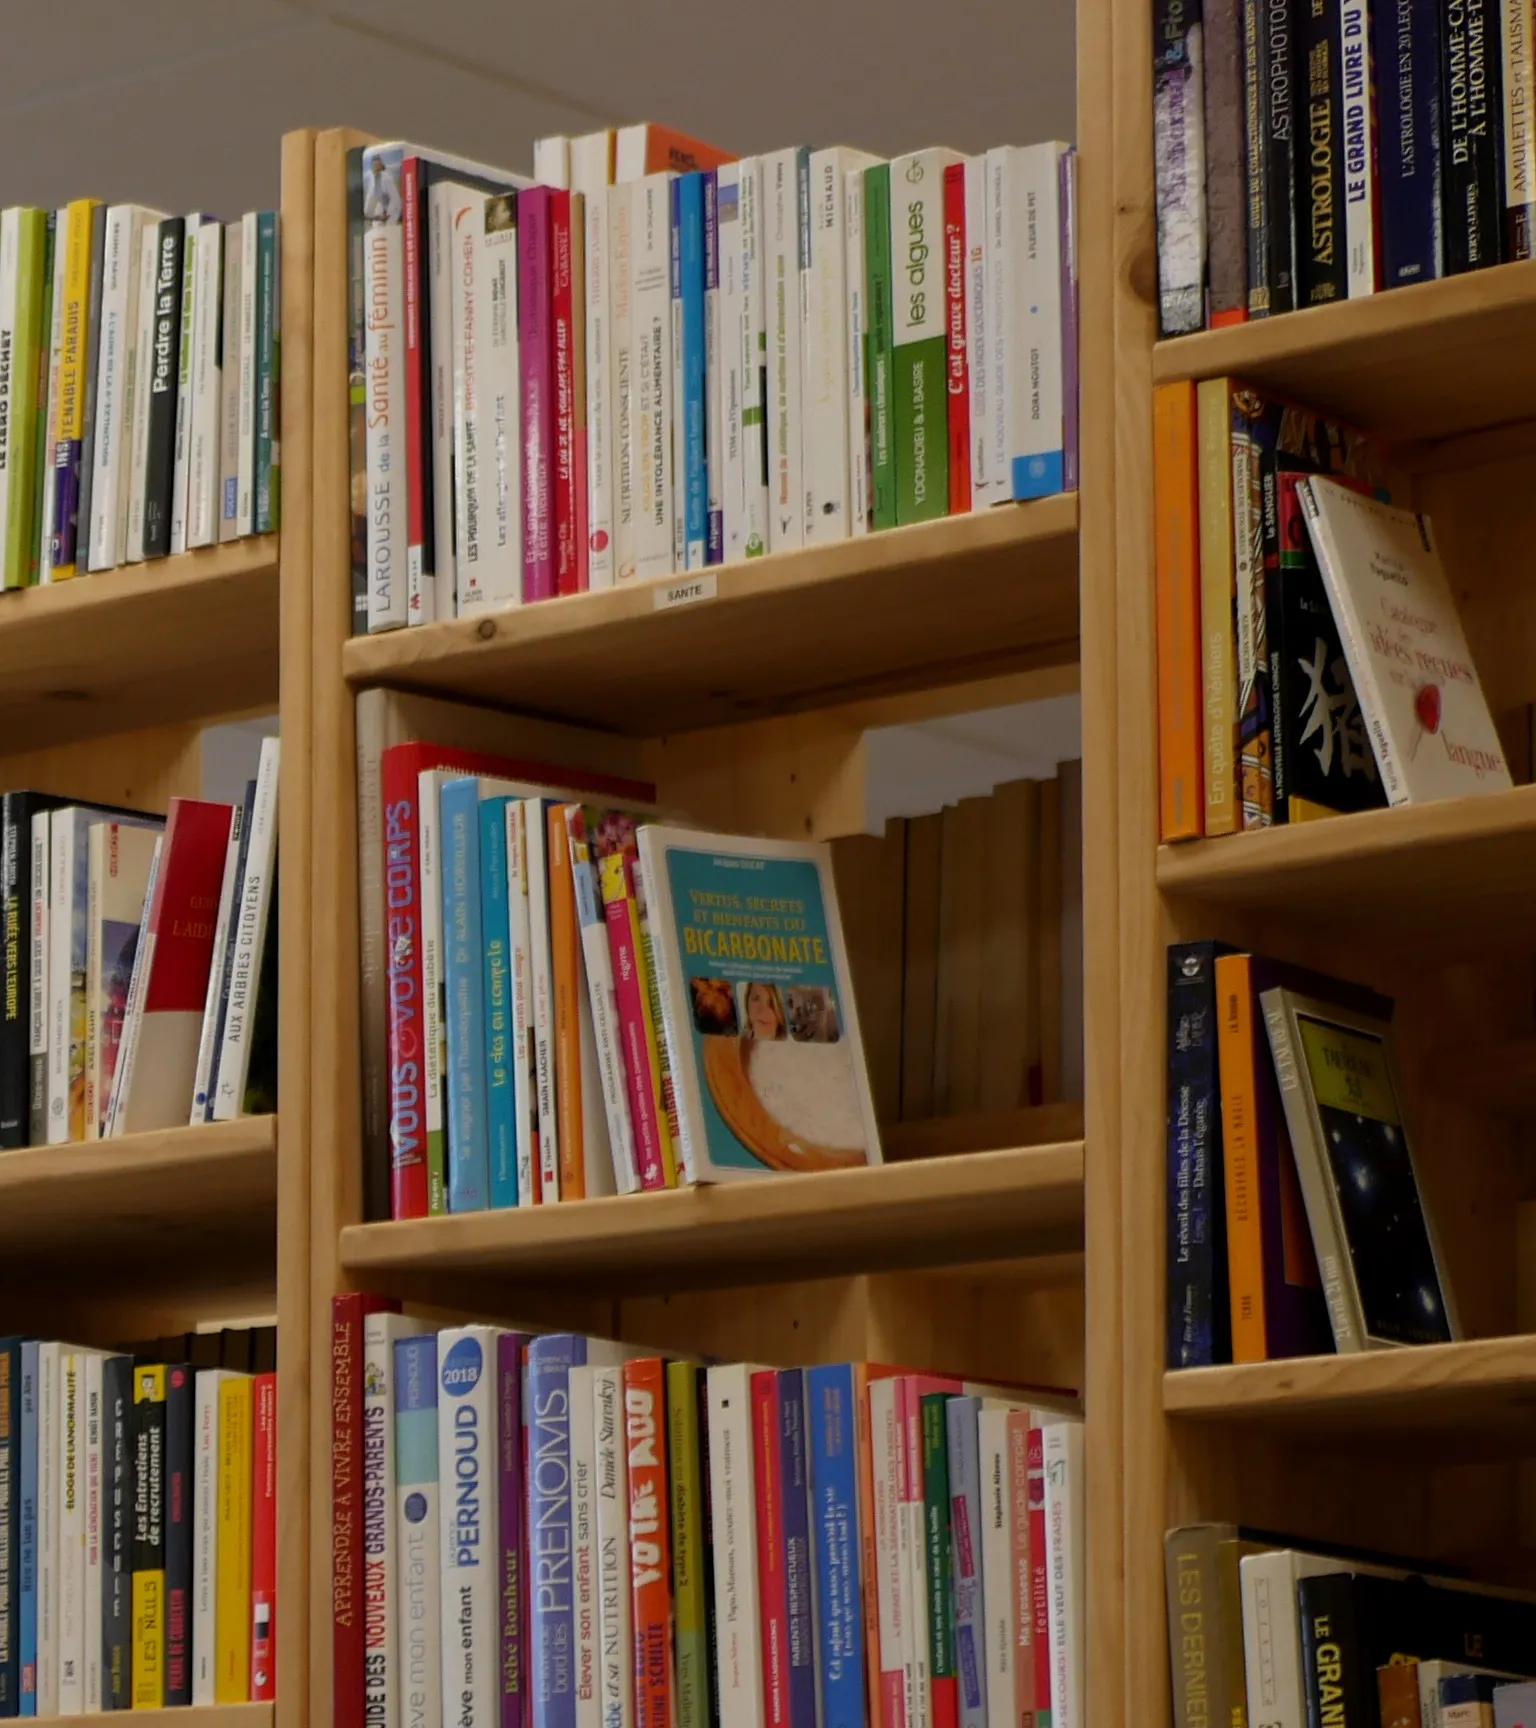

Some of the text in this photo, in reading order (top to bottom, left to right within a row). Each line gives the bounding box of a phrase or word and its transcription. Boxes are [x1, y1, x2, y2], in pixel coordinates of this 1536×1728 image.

[1400, 34, 1413, 49] 20
[1401, 54, 1413, 72] EN
[1343, 9, 1366, 203] LE GRAND LIVRE DU
[1400, 75, 1415, 177] L'ASTROLOGIE
[1452, 135, 1469, 164] DE
[1465, 121, 1486, 136] À
[1512, 88, 1526, 192] AMULETTES
[1309, 99, 1334, 265] ASTROLOGIE
[153, 237, 174, 392] Perdre la Terre
[905, 201, 927, 327] les algues
[946, 224, 967, 395] C'est grave docteur ?
[367, 236, 395, 611] LAROUSSE de la Santé au féminin
[667, 584, 703, 602] SANTE
[228, 875, 261, 1043] AUX ARBRES CITOYENS
[386, 800, 421, 1159] VOUS CORPS
[684, 926, 827, 965] BICARBONATE
[444, 1367, 477, 1385] 2018
[134, 1433, 148, 1542] Les Entretiens
[148, 1426, 162, 1545] de recrutement
[332, 1322, 353, 1626] APPRENDRE À VIVRE ENSEMBLE
[365, 1406, 385, 1554] GRANDS-PARENTS
[454, 1405, 481, 1568] PERNOUD
[530, 1387, 570, 1613] PRÉNOMS
[365, 1560, 386, 1648] NOUVEAUX
[403, 1532, 425, 1621] enfant
[457, 1585, 473, 1649] enfant
[574, 1460, 594, 1700] Élever son enfant sans crier
[1313, 1615, 1330, 1640] LE
[365, 1654, 387, 1688] DES
[407, 1627, 425, 1684] mon
[462, 1651, 473, 1684] mon
